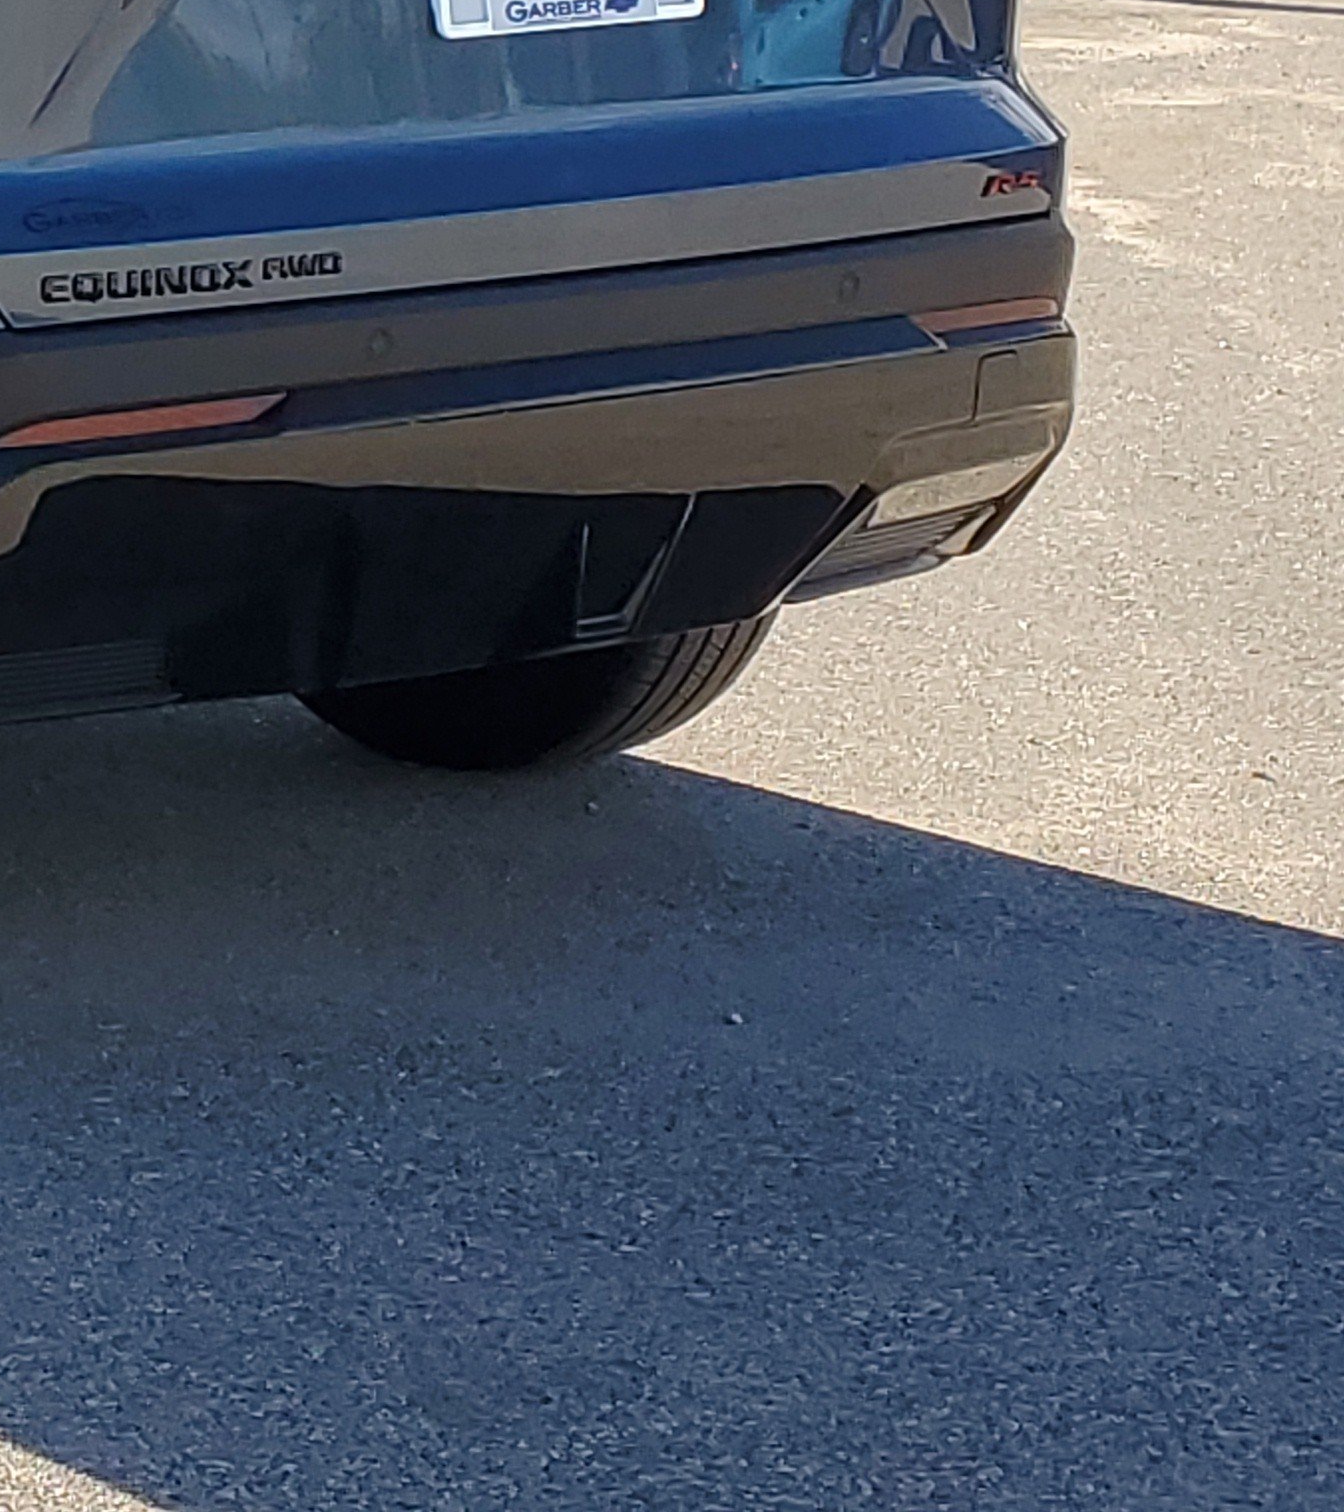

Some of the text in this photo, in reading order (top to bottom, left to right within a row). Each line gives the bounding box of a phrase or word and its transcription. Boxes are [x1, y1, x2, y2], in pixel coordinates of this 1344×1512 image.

[505, 0, 602, 22] GARBER
[981, 171, 1040, 197] RS
[40, 251, 343, 304] EQUINOX AWD
